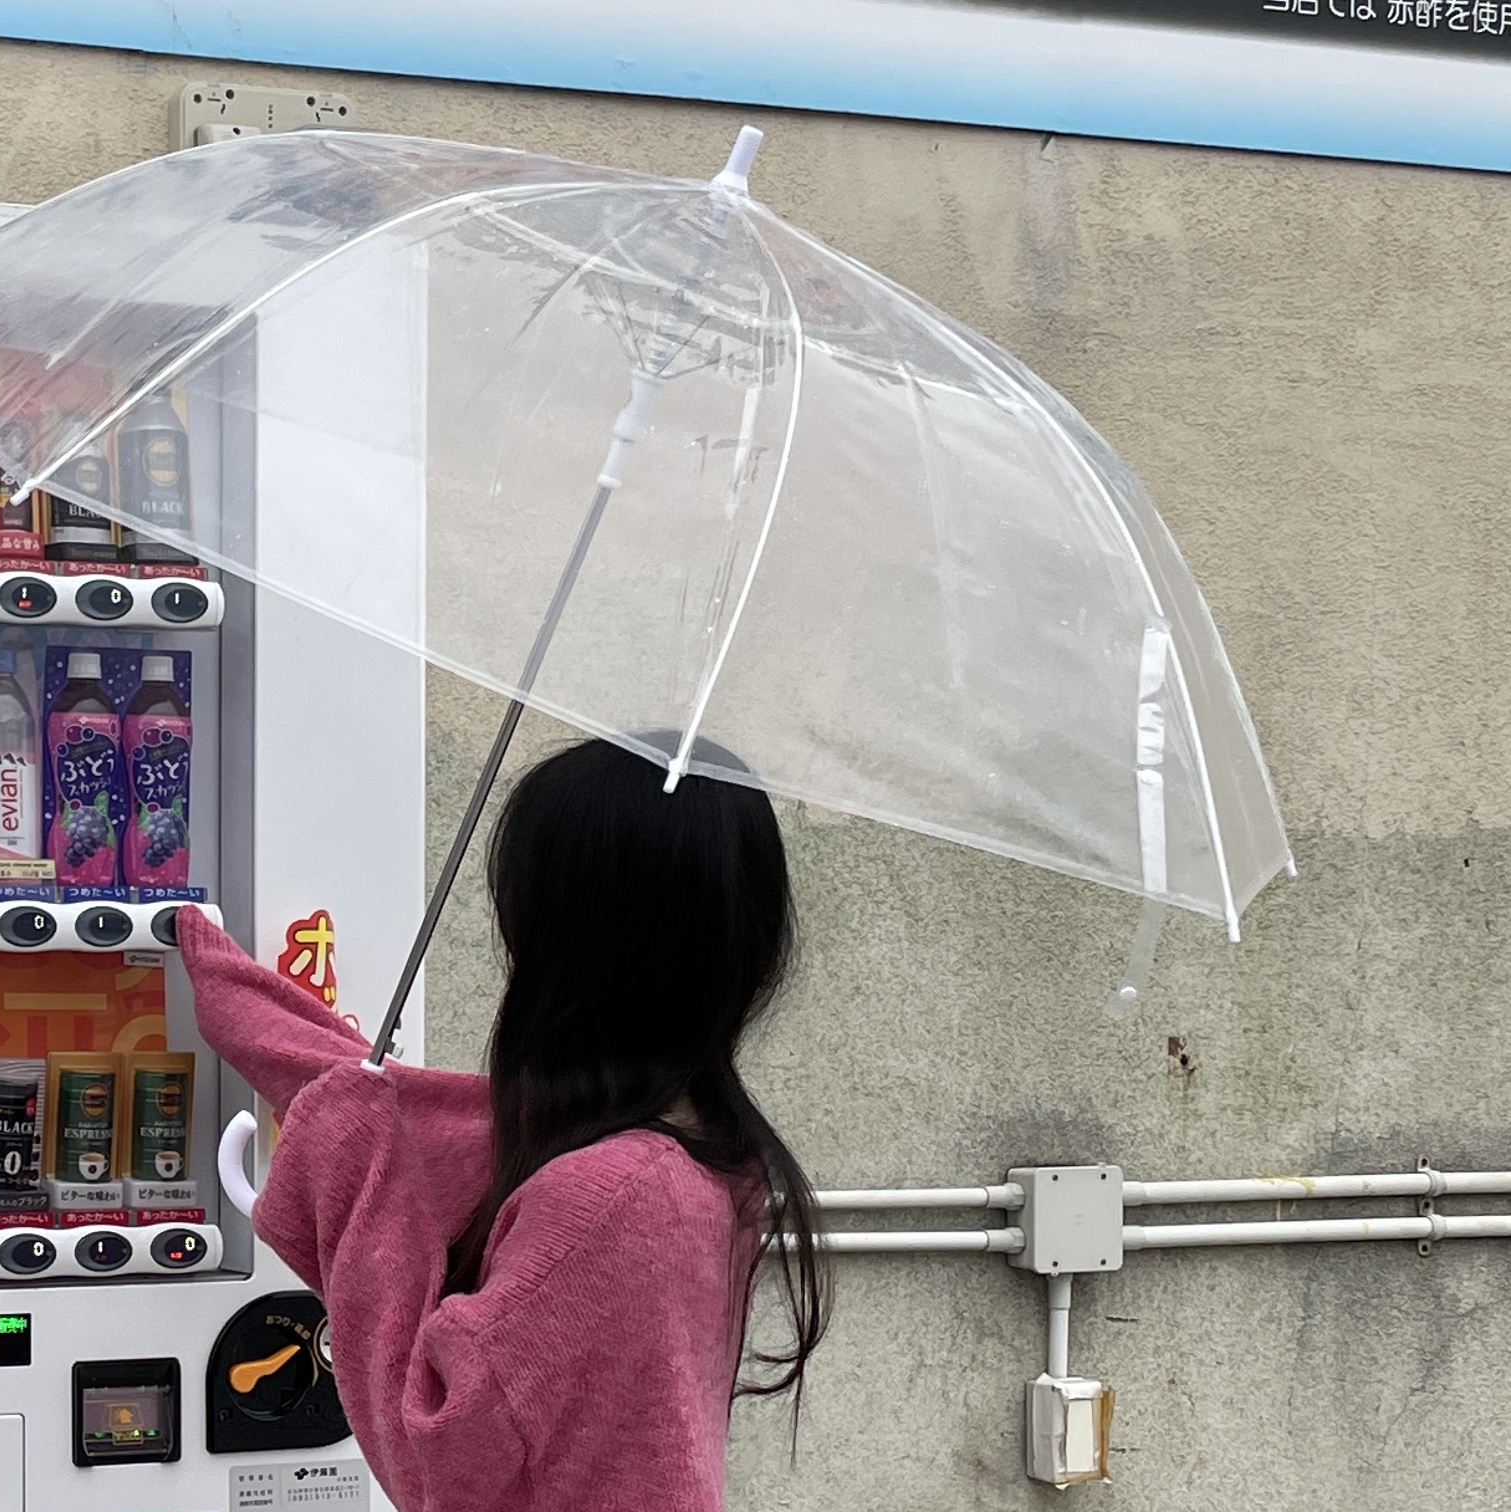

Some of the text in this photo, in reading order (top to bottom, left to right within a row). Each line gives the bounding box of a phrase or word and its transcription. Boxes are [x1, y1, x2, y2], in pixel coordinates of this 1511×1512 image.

[142, 500, 185, 515] BLACK
[61, 749, 114, 782] ぶどう
[137, 752, 189, 785] ぶどう
[68, 887, 126, 898] つめた〜い
[143, 888, 200, 898] つめた〜い
[4, 1150, 22, 1175] 0
